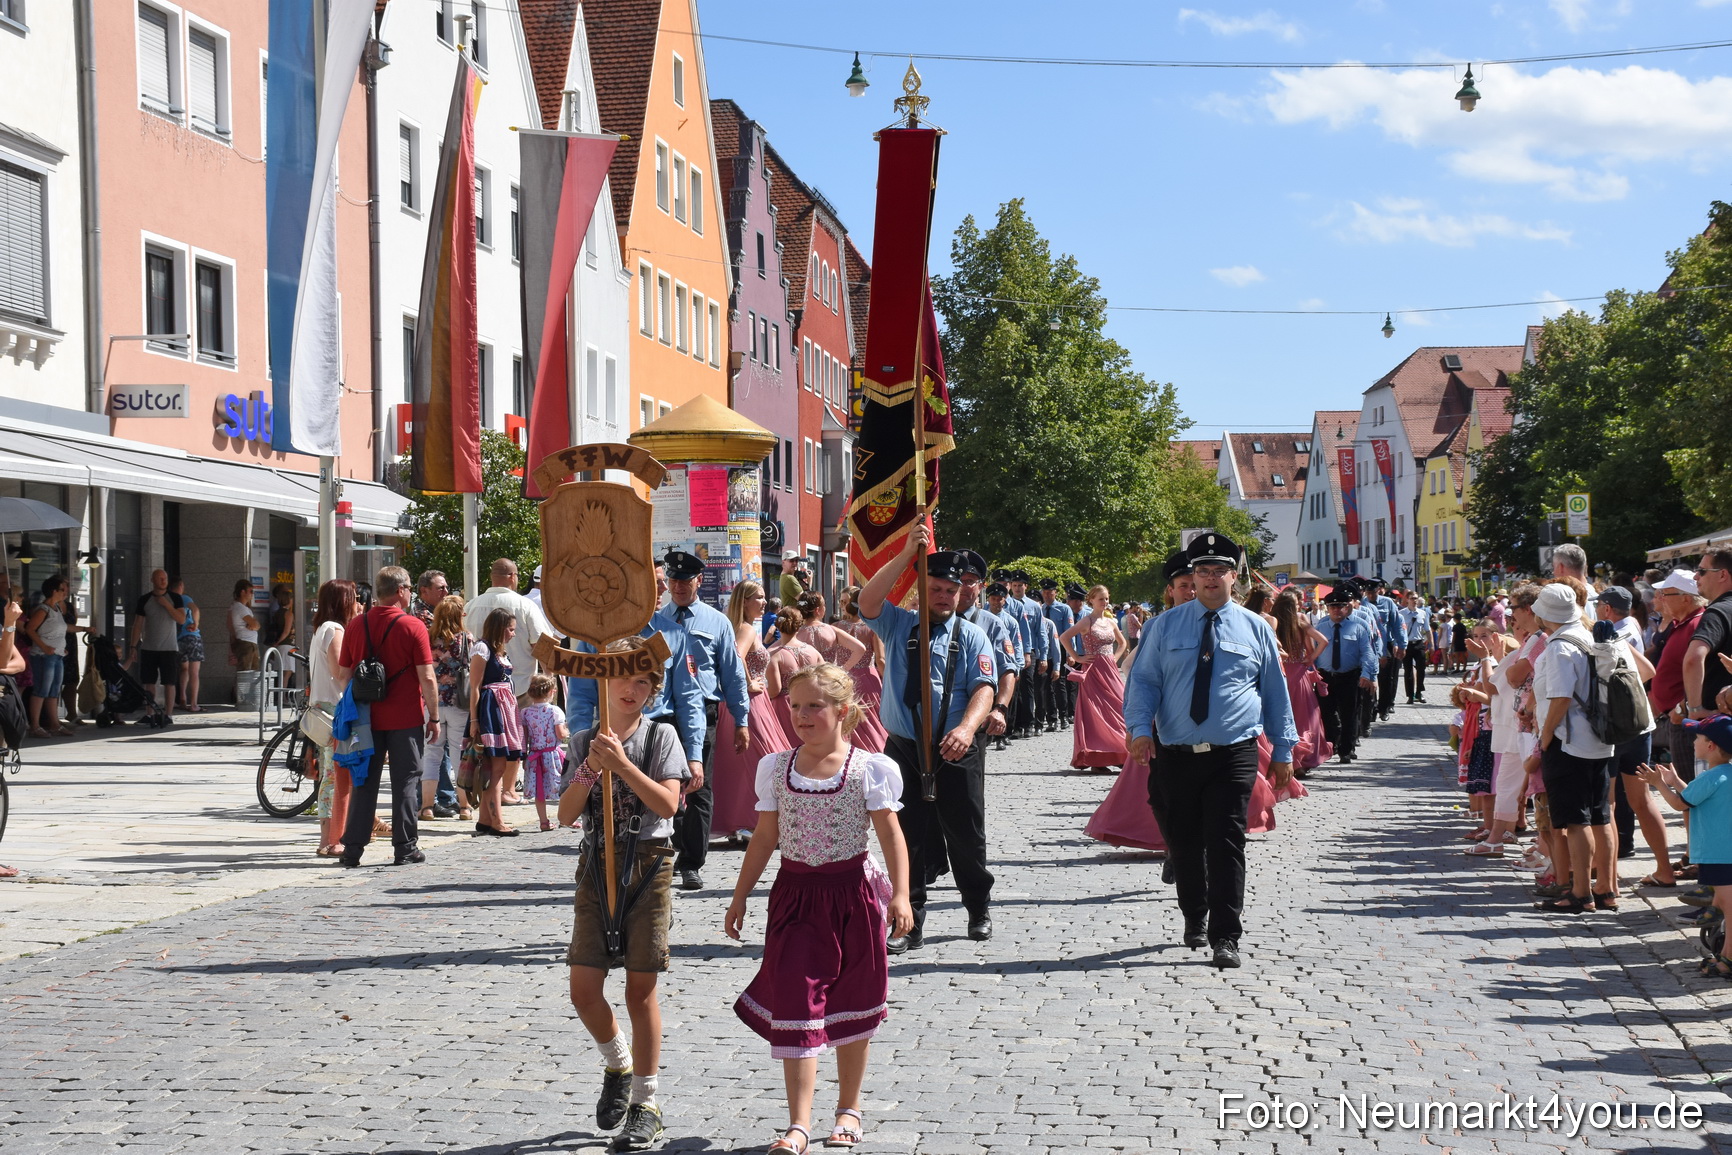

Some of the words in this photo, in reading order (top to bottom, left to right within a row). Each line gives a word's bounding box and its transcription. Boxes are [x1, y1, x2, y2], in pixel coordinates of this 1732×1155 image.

[113, 389, 182, 411] sutor.
[224, 391, 273, 444] sut
[558, 445, 634, 472] FFW
[553, 650, 652, 677] WISSING
